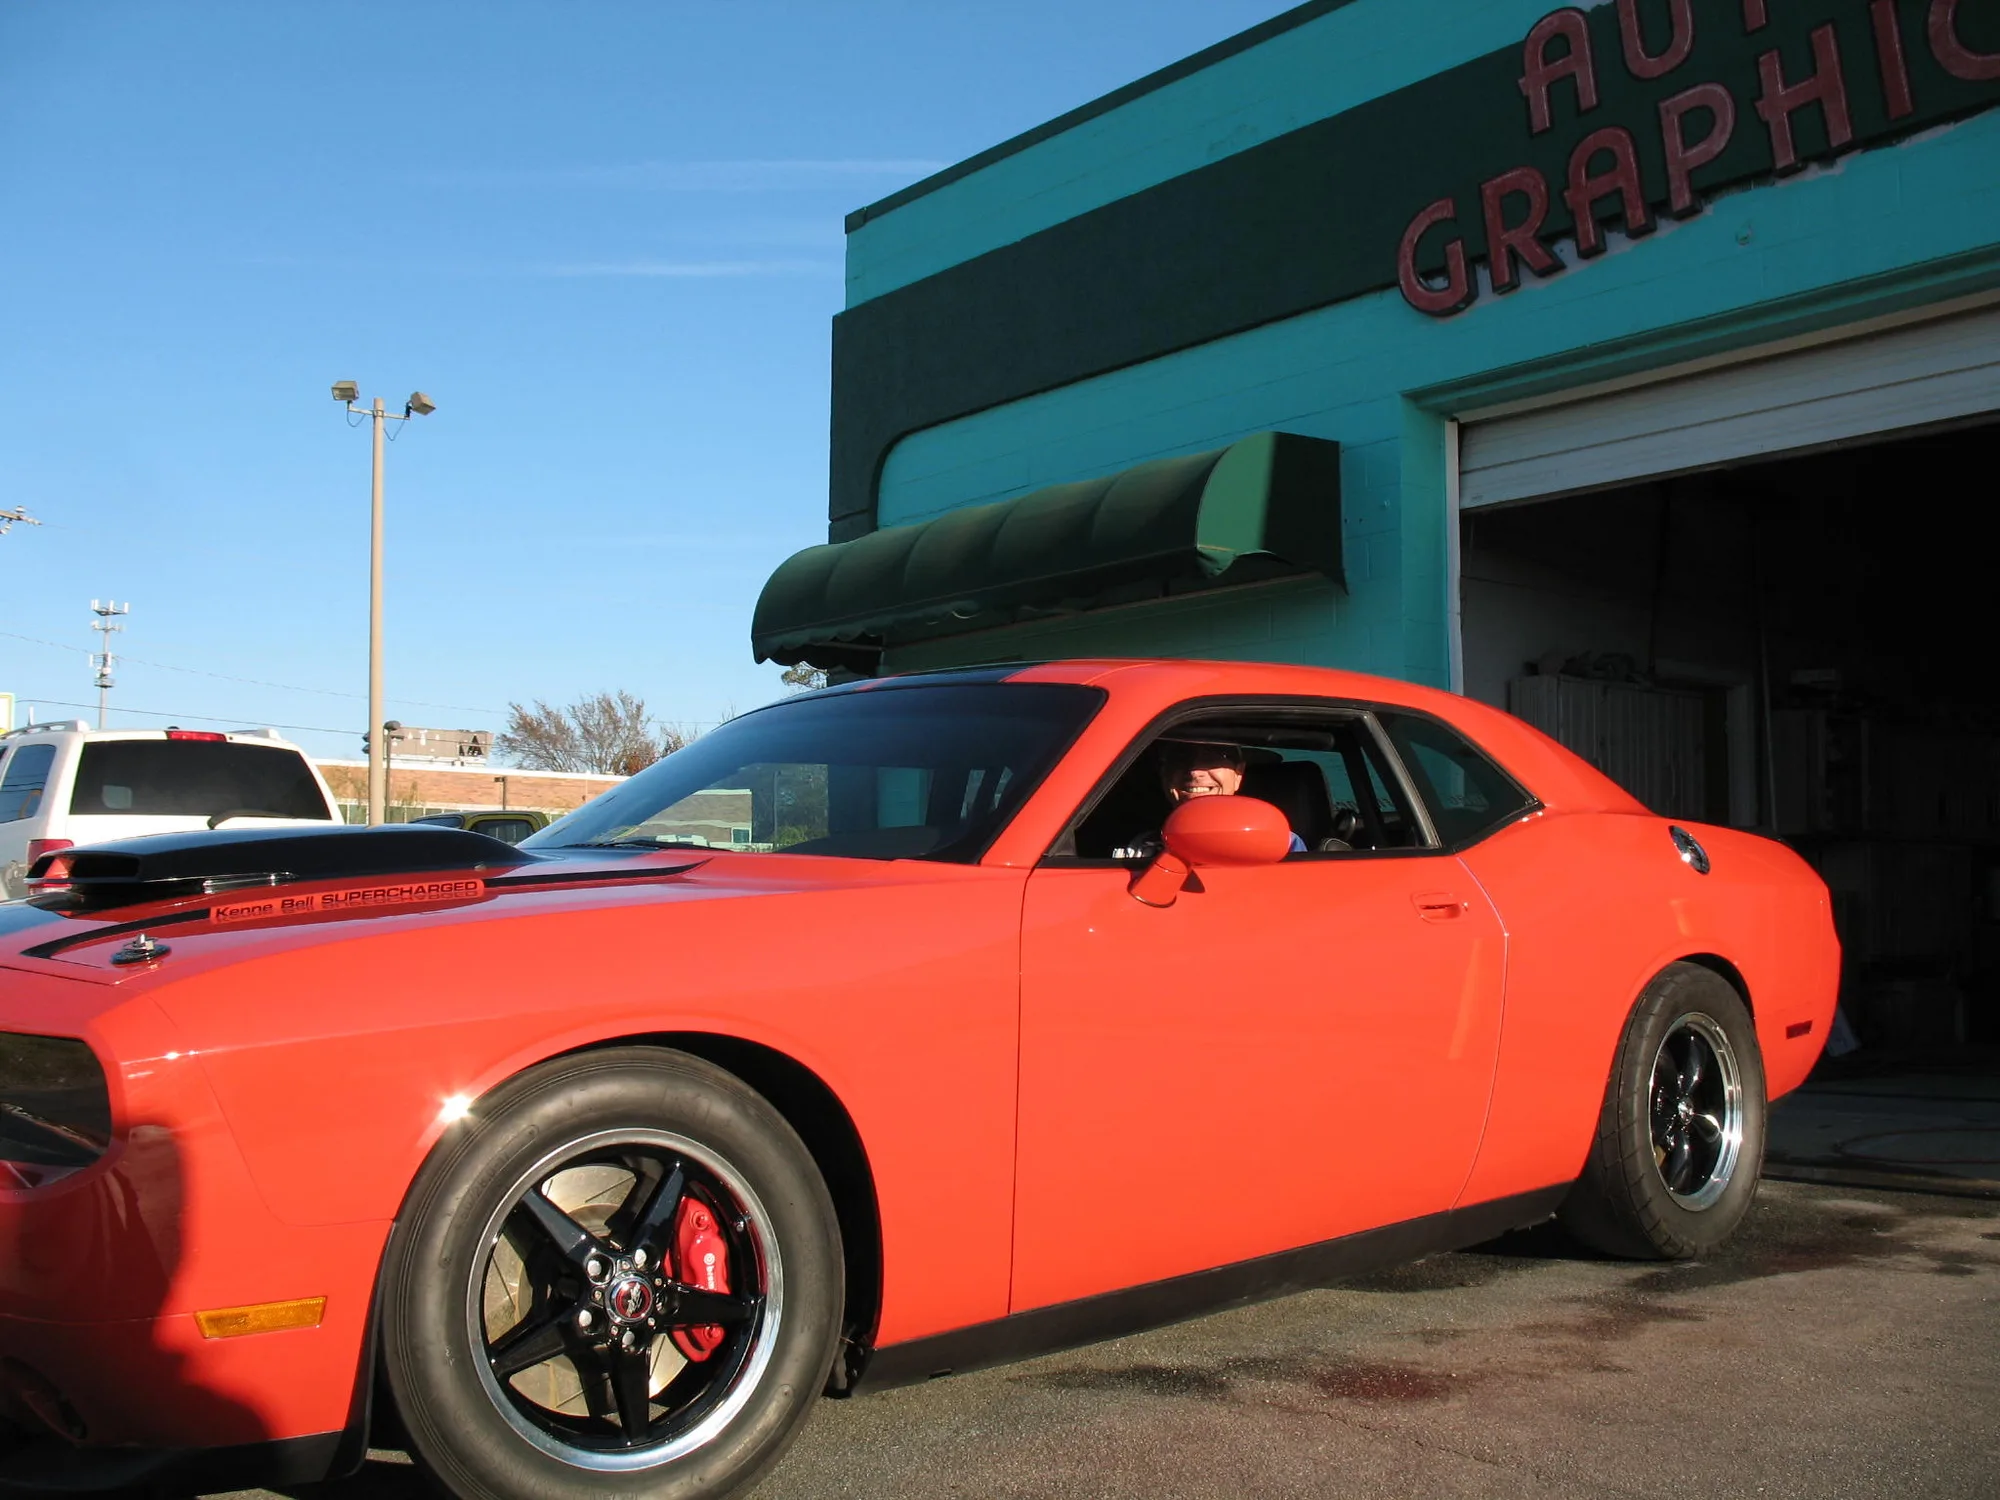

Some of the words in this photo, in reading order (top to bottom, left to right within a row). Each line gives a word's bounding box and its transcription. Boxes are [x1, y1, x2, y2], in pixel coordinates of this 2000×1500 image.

[215, 903, 273, 918] Kenne
[280, 896, 314, 909] Bell
[320, 881, 478, 904] SUPERCHARGED
